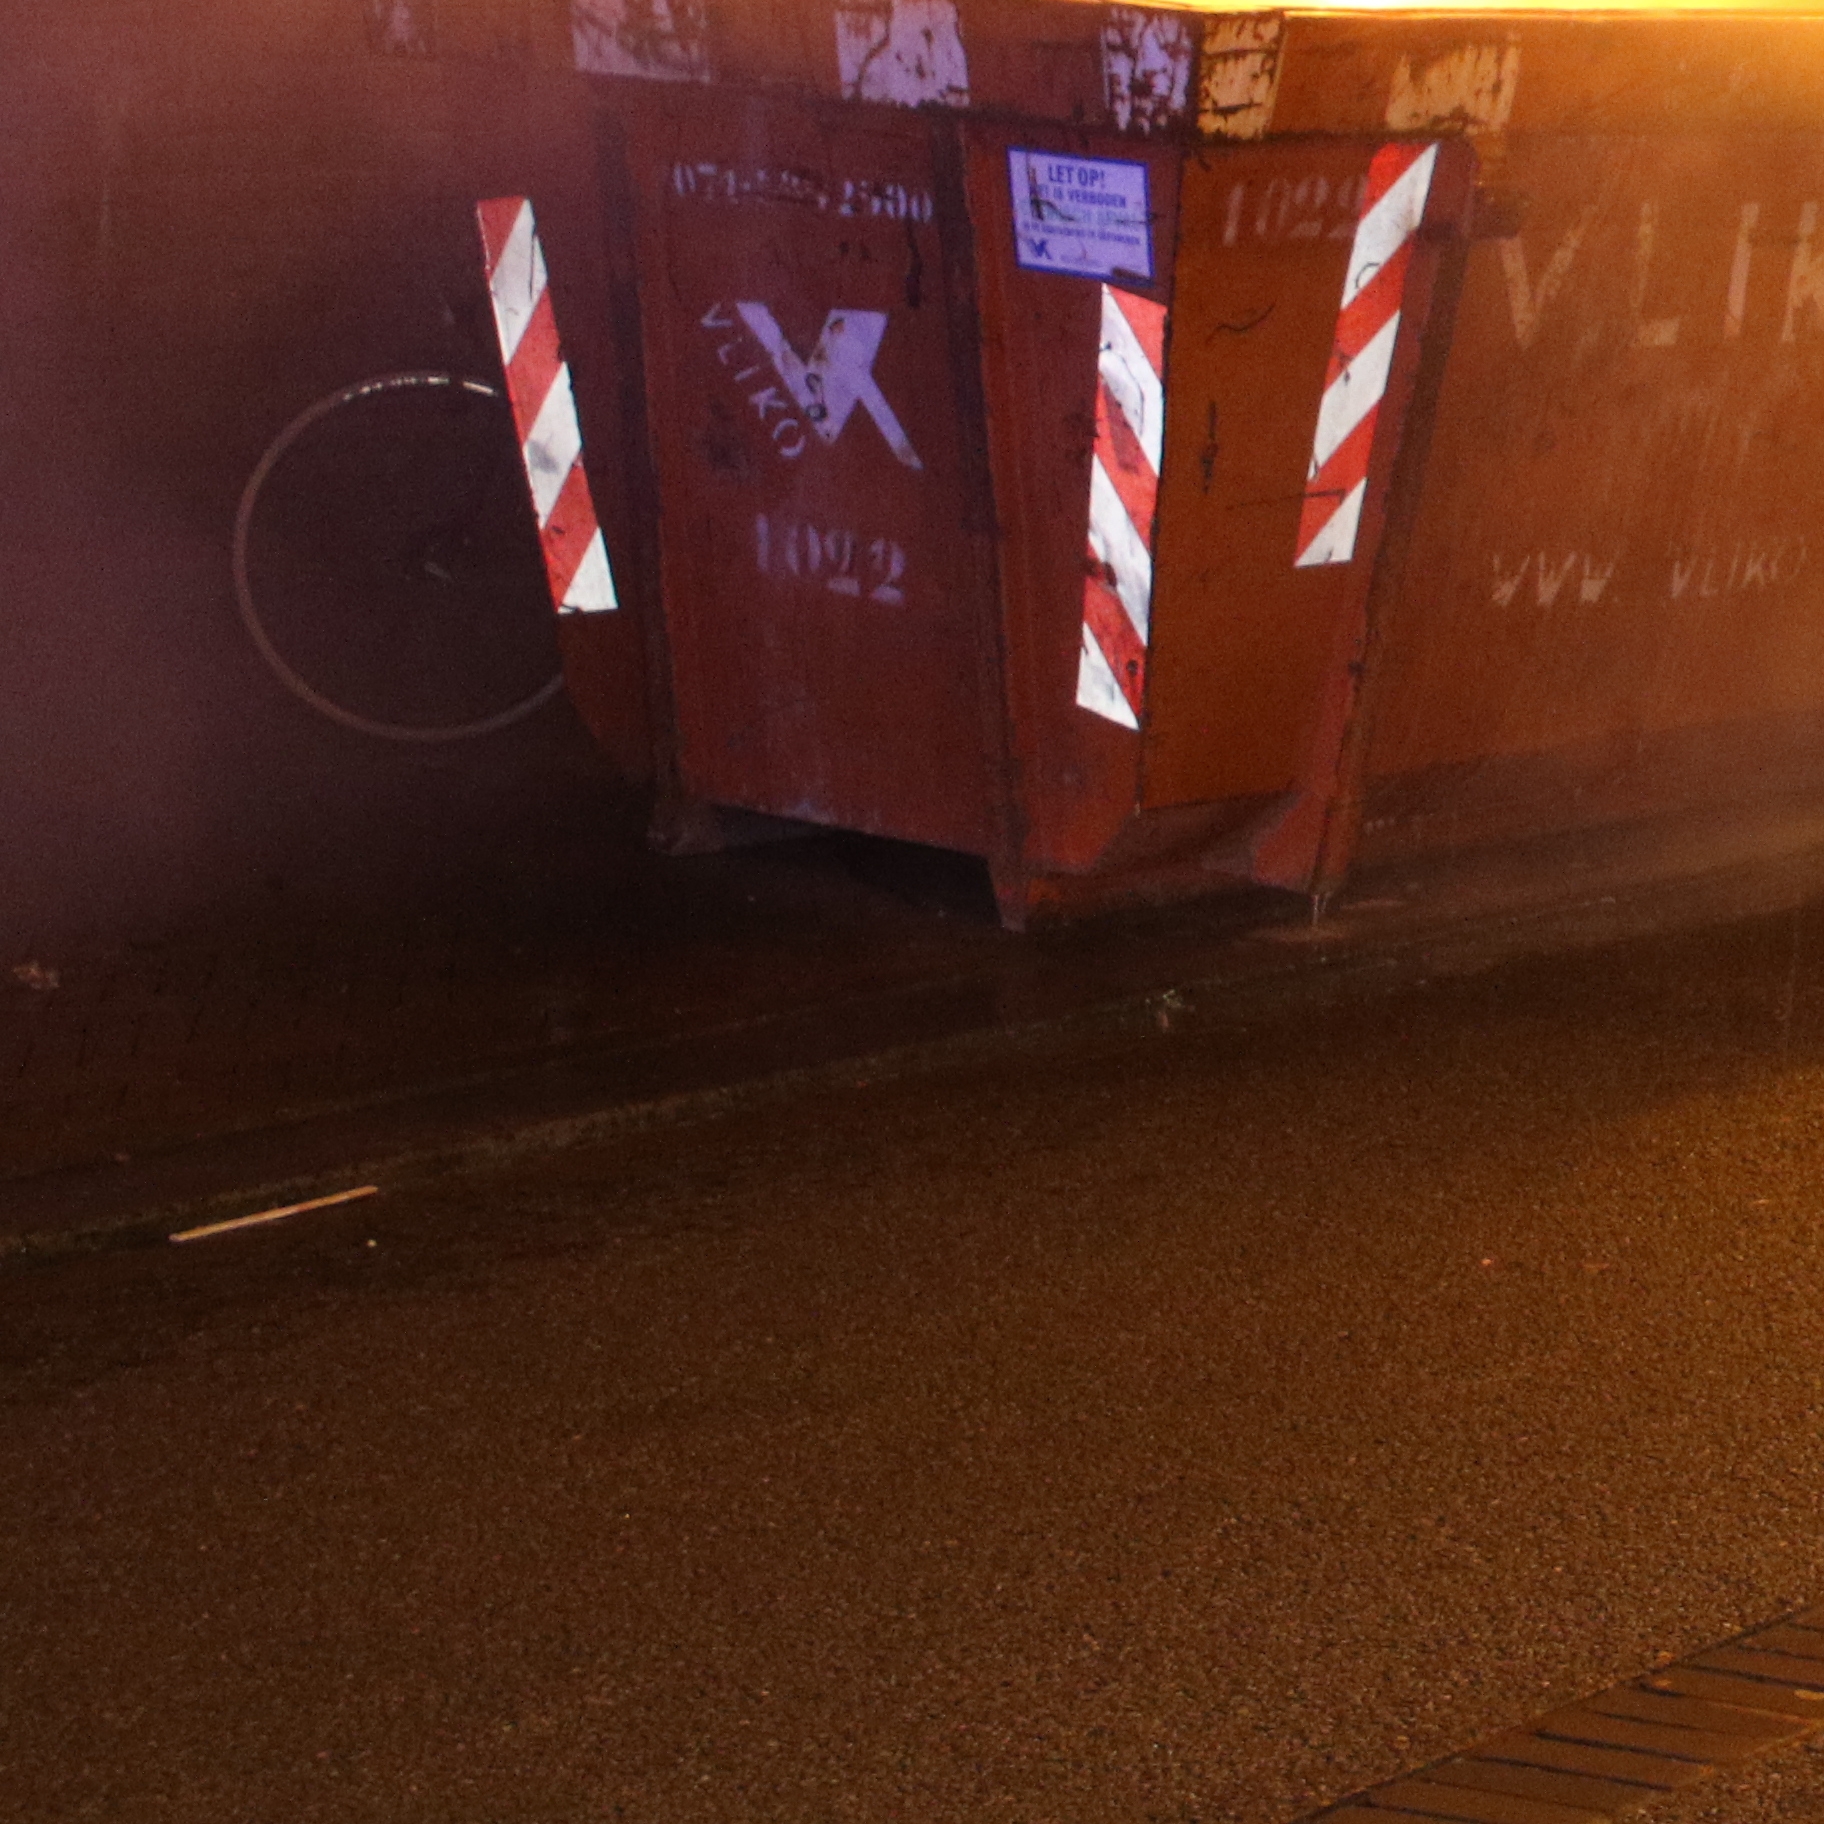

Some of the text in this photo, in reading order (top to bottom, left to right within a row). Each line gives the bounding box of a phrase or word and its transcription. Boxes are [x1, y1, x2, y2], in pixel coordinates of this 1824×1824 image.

[1048, 164, 1106, 191] LET OP!
[700, 303, 807, 458] VLIKO
[755, 513, 908, 606] 1022
